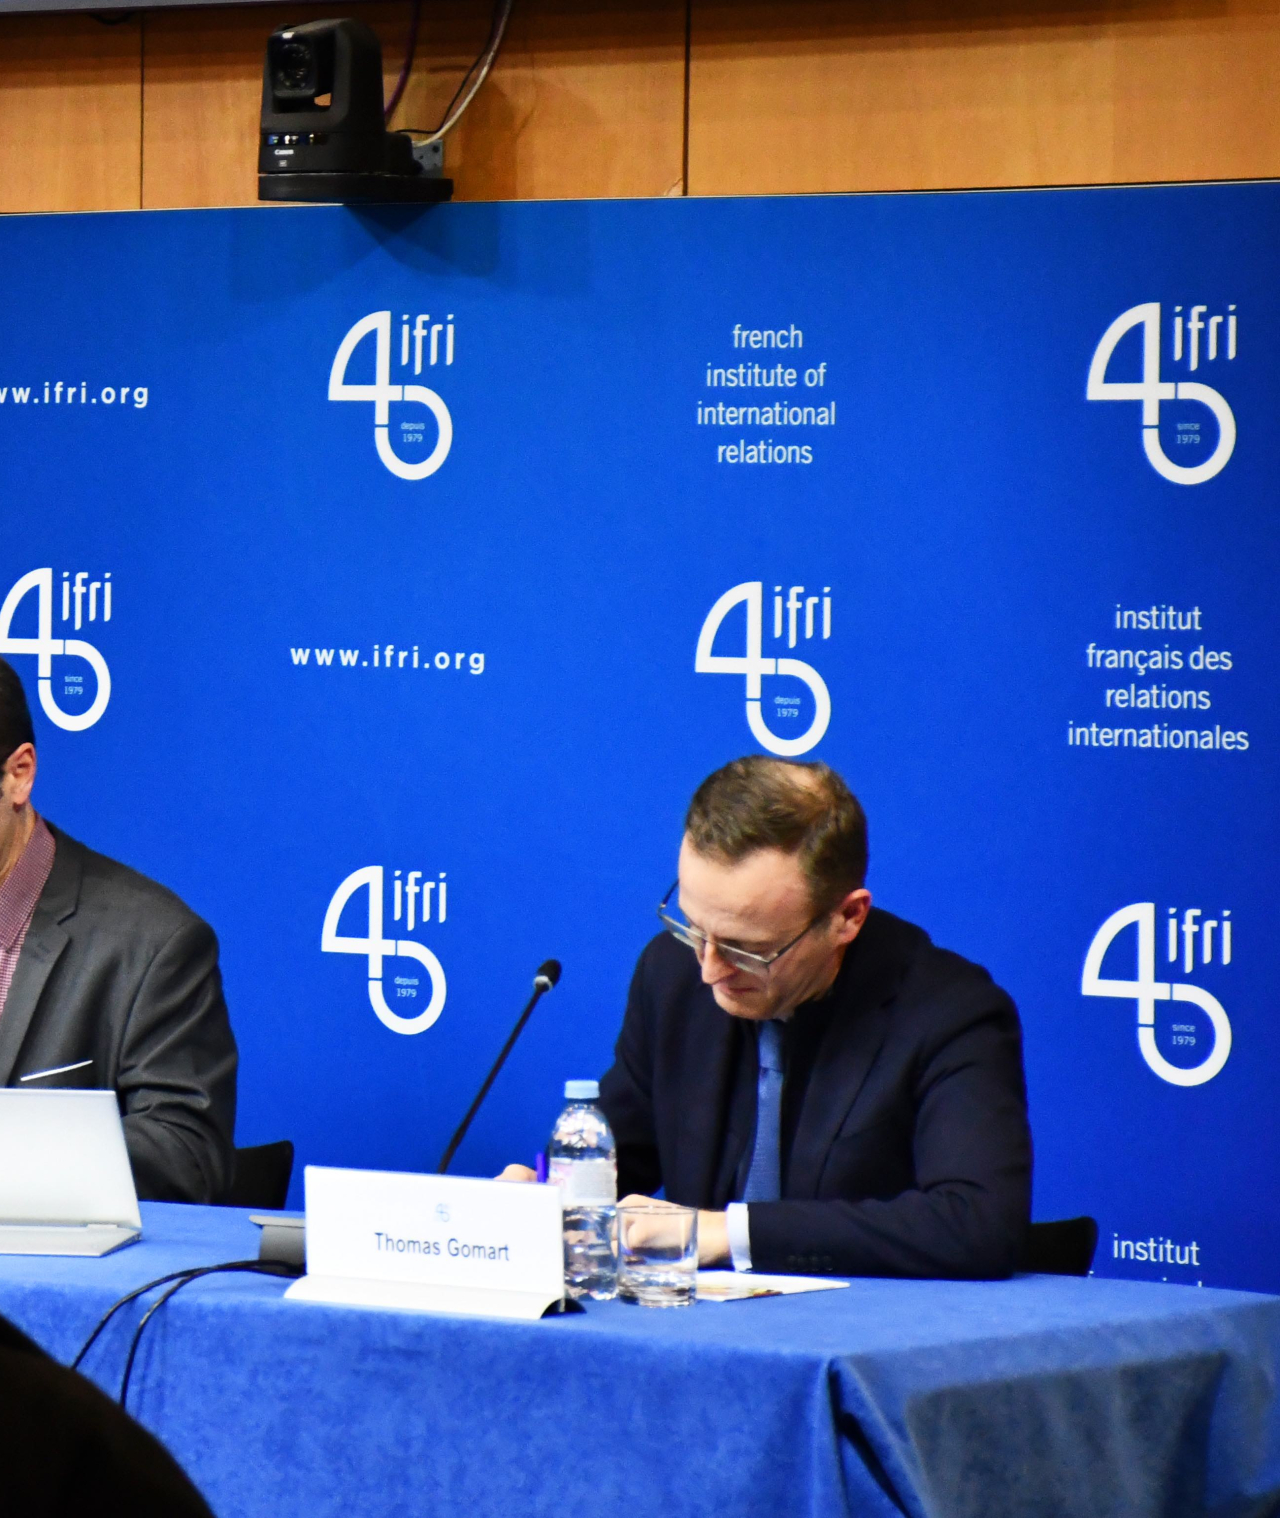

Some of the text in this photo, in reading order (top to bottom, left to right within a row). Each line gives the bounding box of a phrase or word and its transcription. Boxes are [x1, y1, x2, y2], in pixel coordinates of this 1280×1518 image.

[402, 314, 454, 375] ifri
[733, 324, 802, 348] french
[1174, 305, 1236, 371] ifri
[707, 363, 826, 387] institute of
[698, 401, 835, 425] international
[400, 421, 426, 431] depuis
[402, 433, 424, 443] 1979
[718, 440, 812, 464] relations
[63, 572, 111, 630] ifri
[774, 586, 831, 648] ifri
[1116, 604, 1202, 630] institut
[291, 645, 484, 674] www.ifri.org
[1086, 643, 1232, 675] français des
[64, 675, 84, 683] since
[64, 685, 84, 695] 1979
[773, 695, 801, 706] depuis
[1106, 684, 1210, 709] relations
[776, 707, 799, 718] 1979
[1069, 721, 1249, 750] internationales
[394, 871, 446, 930] ifri
[1169, 908, 1231, 973] ifri
[393, 976, 420, 986] depuis
[396, 987, 418, 998] 1979
[1171, 1023, 1196, 1033] since
[1172, 1035, 1197, 1047] 1979
[375, 1233, 509, 1261] Thomas Gomart
[1114, 1234, 1199, 1265] institut
